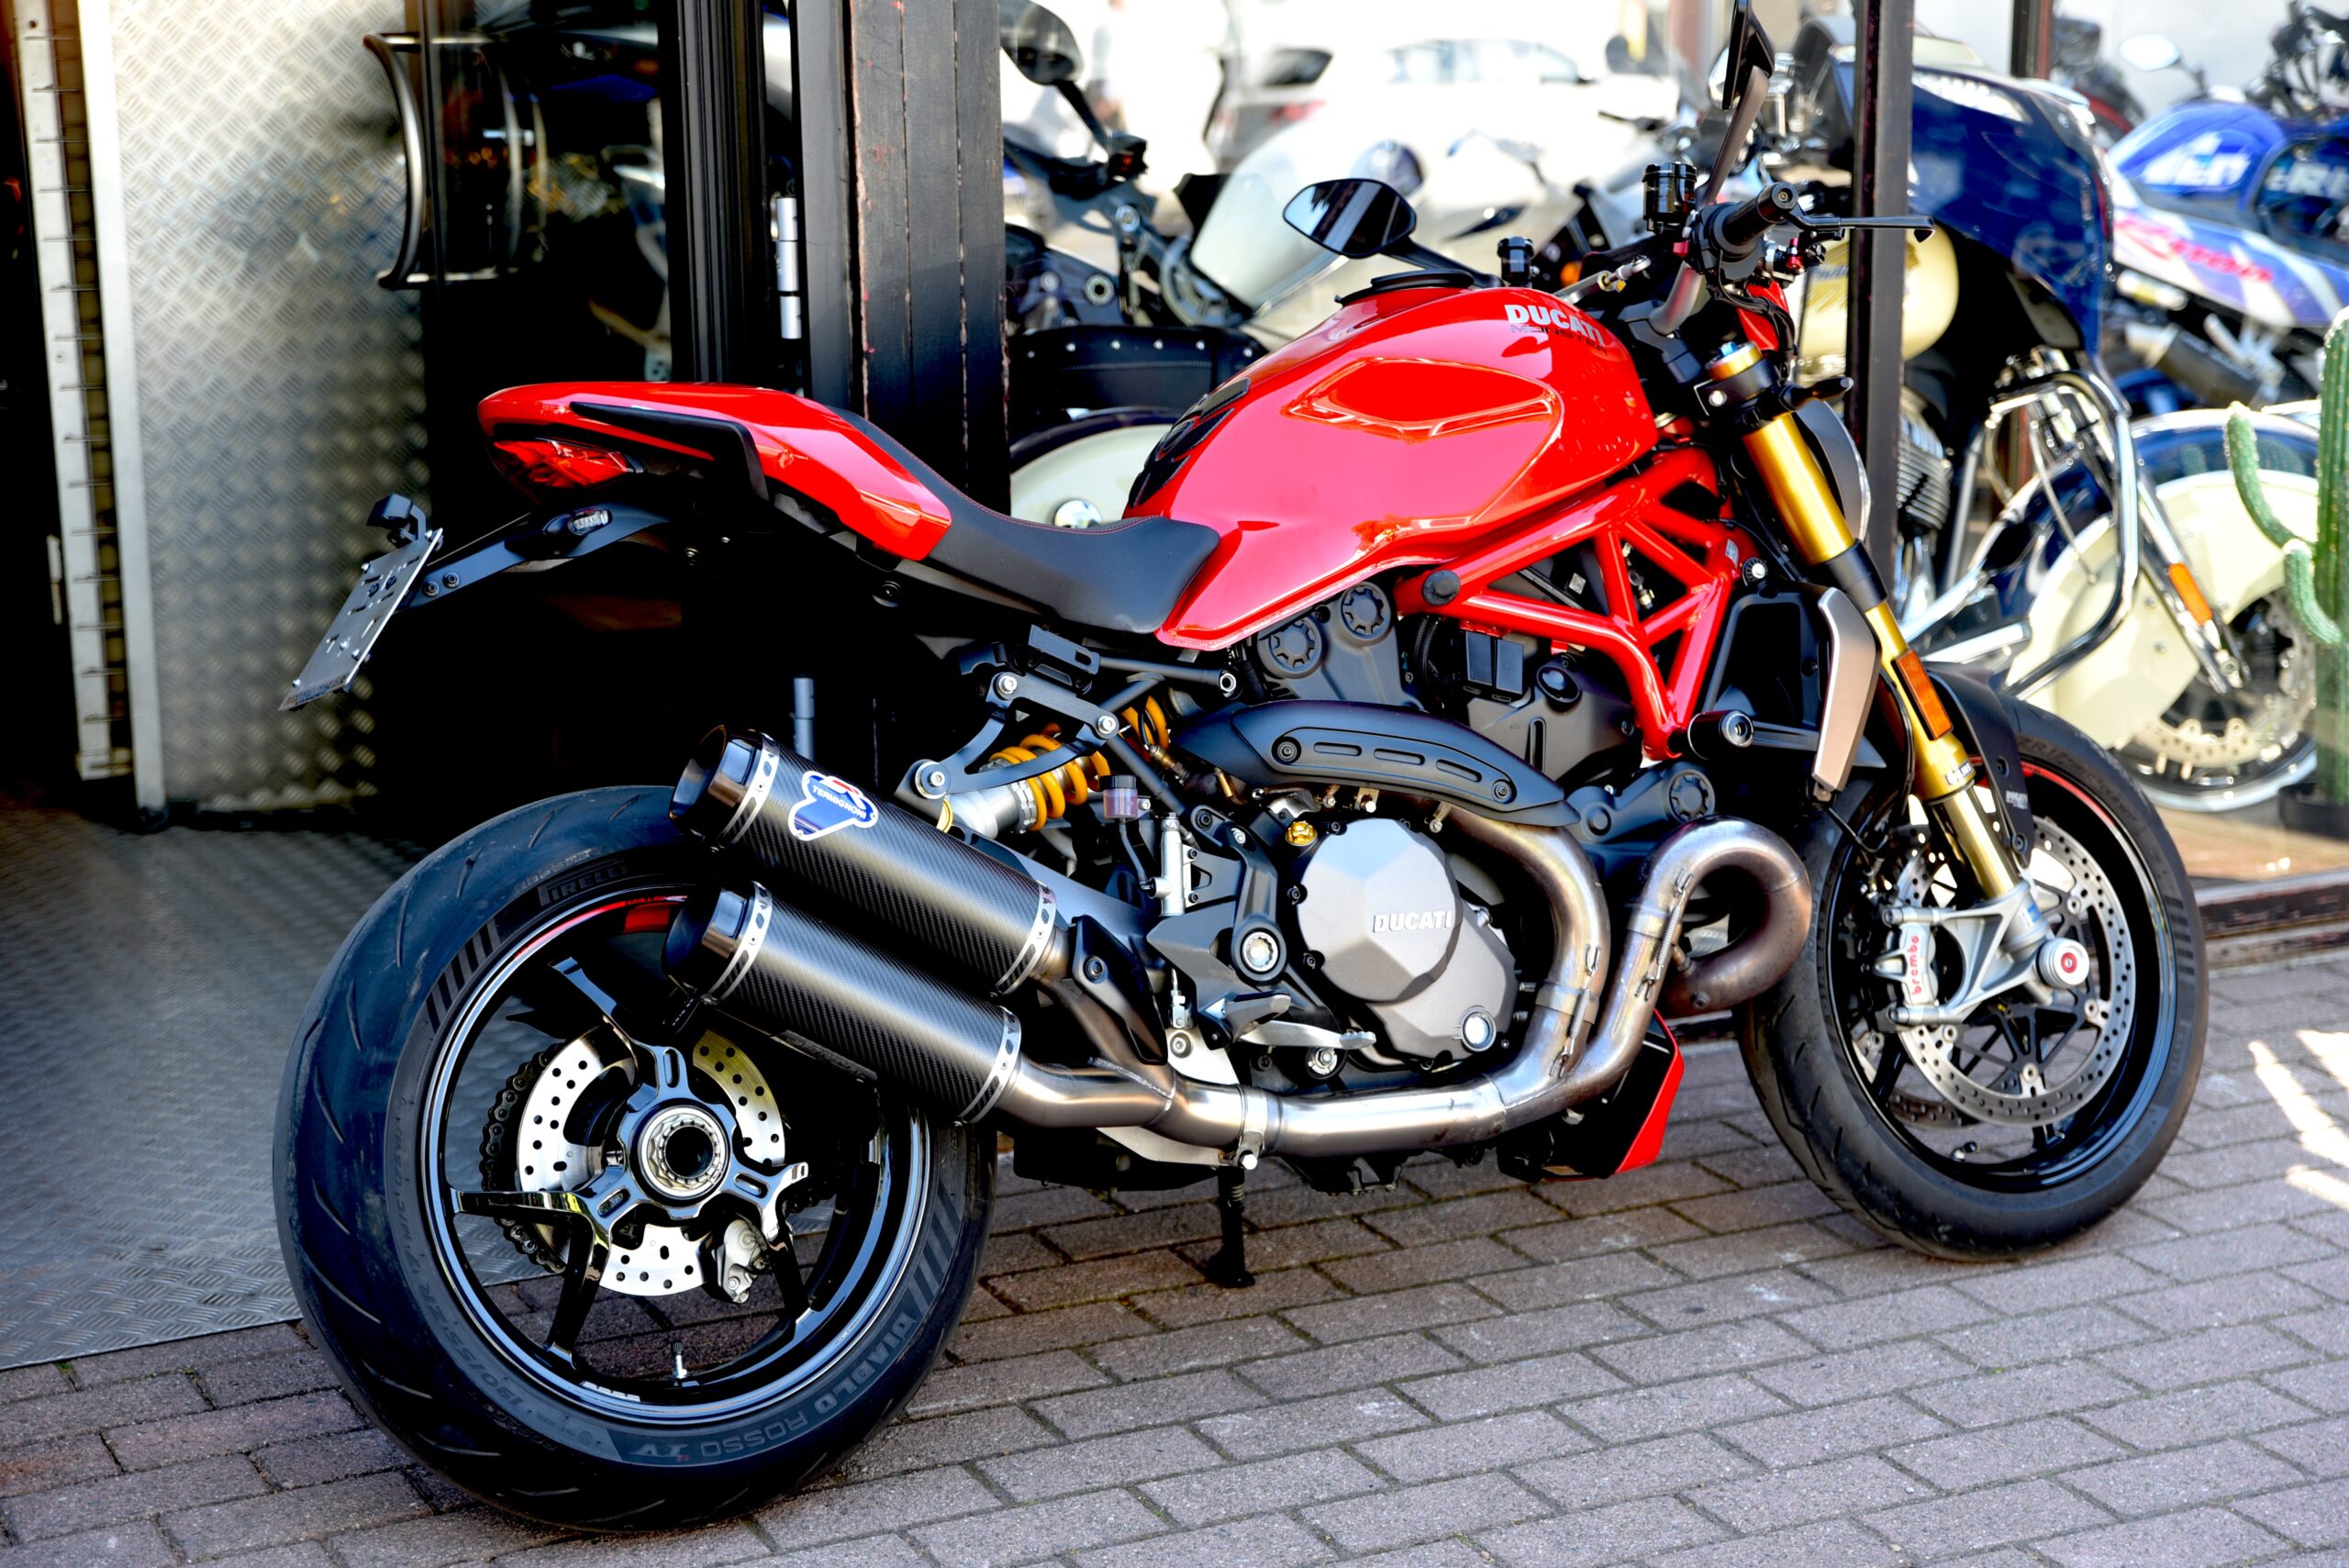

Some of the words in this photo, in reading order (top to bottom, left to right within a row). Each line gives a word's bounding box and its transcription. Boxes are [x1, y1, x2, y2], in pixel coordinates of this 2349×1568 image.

[1504, 304, 1606, 348] DUCATI
[812, 785, 867, 819] TERMIGNONI
[536, 852, 632, 907] PIRELLI
[1373, 910, 1453, 933] DUCATI
[1907, 935, 1922, 995] brembo
[813, 1311, 917, 1416] DIABLO
[700, 1410, 808, 1458] ROSSO
